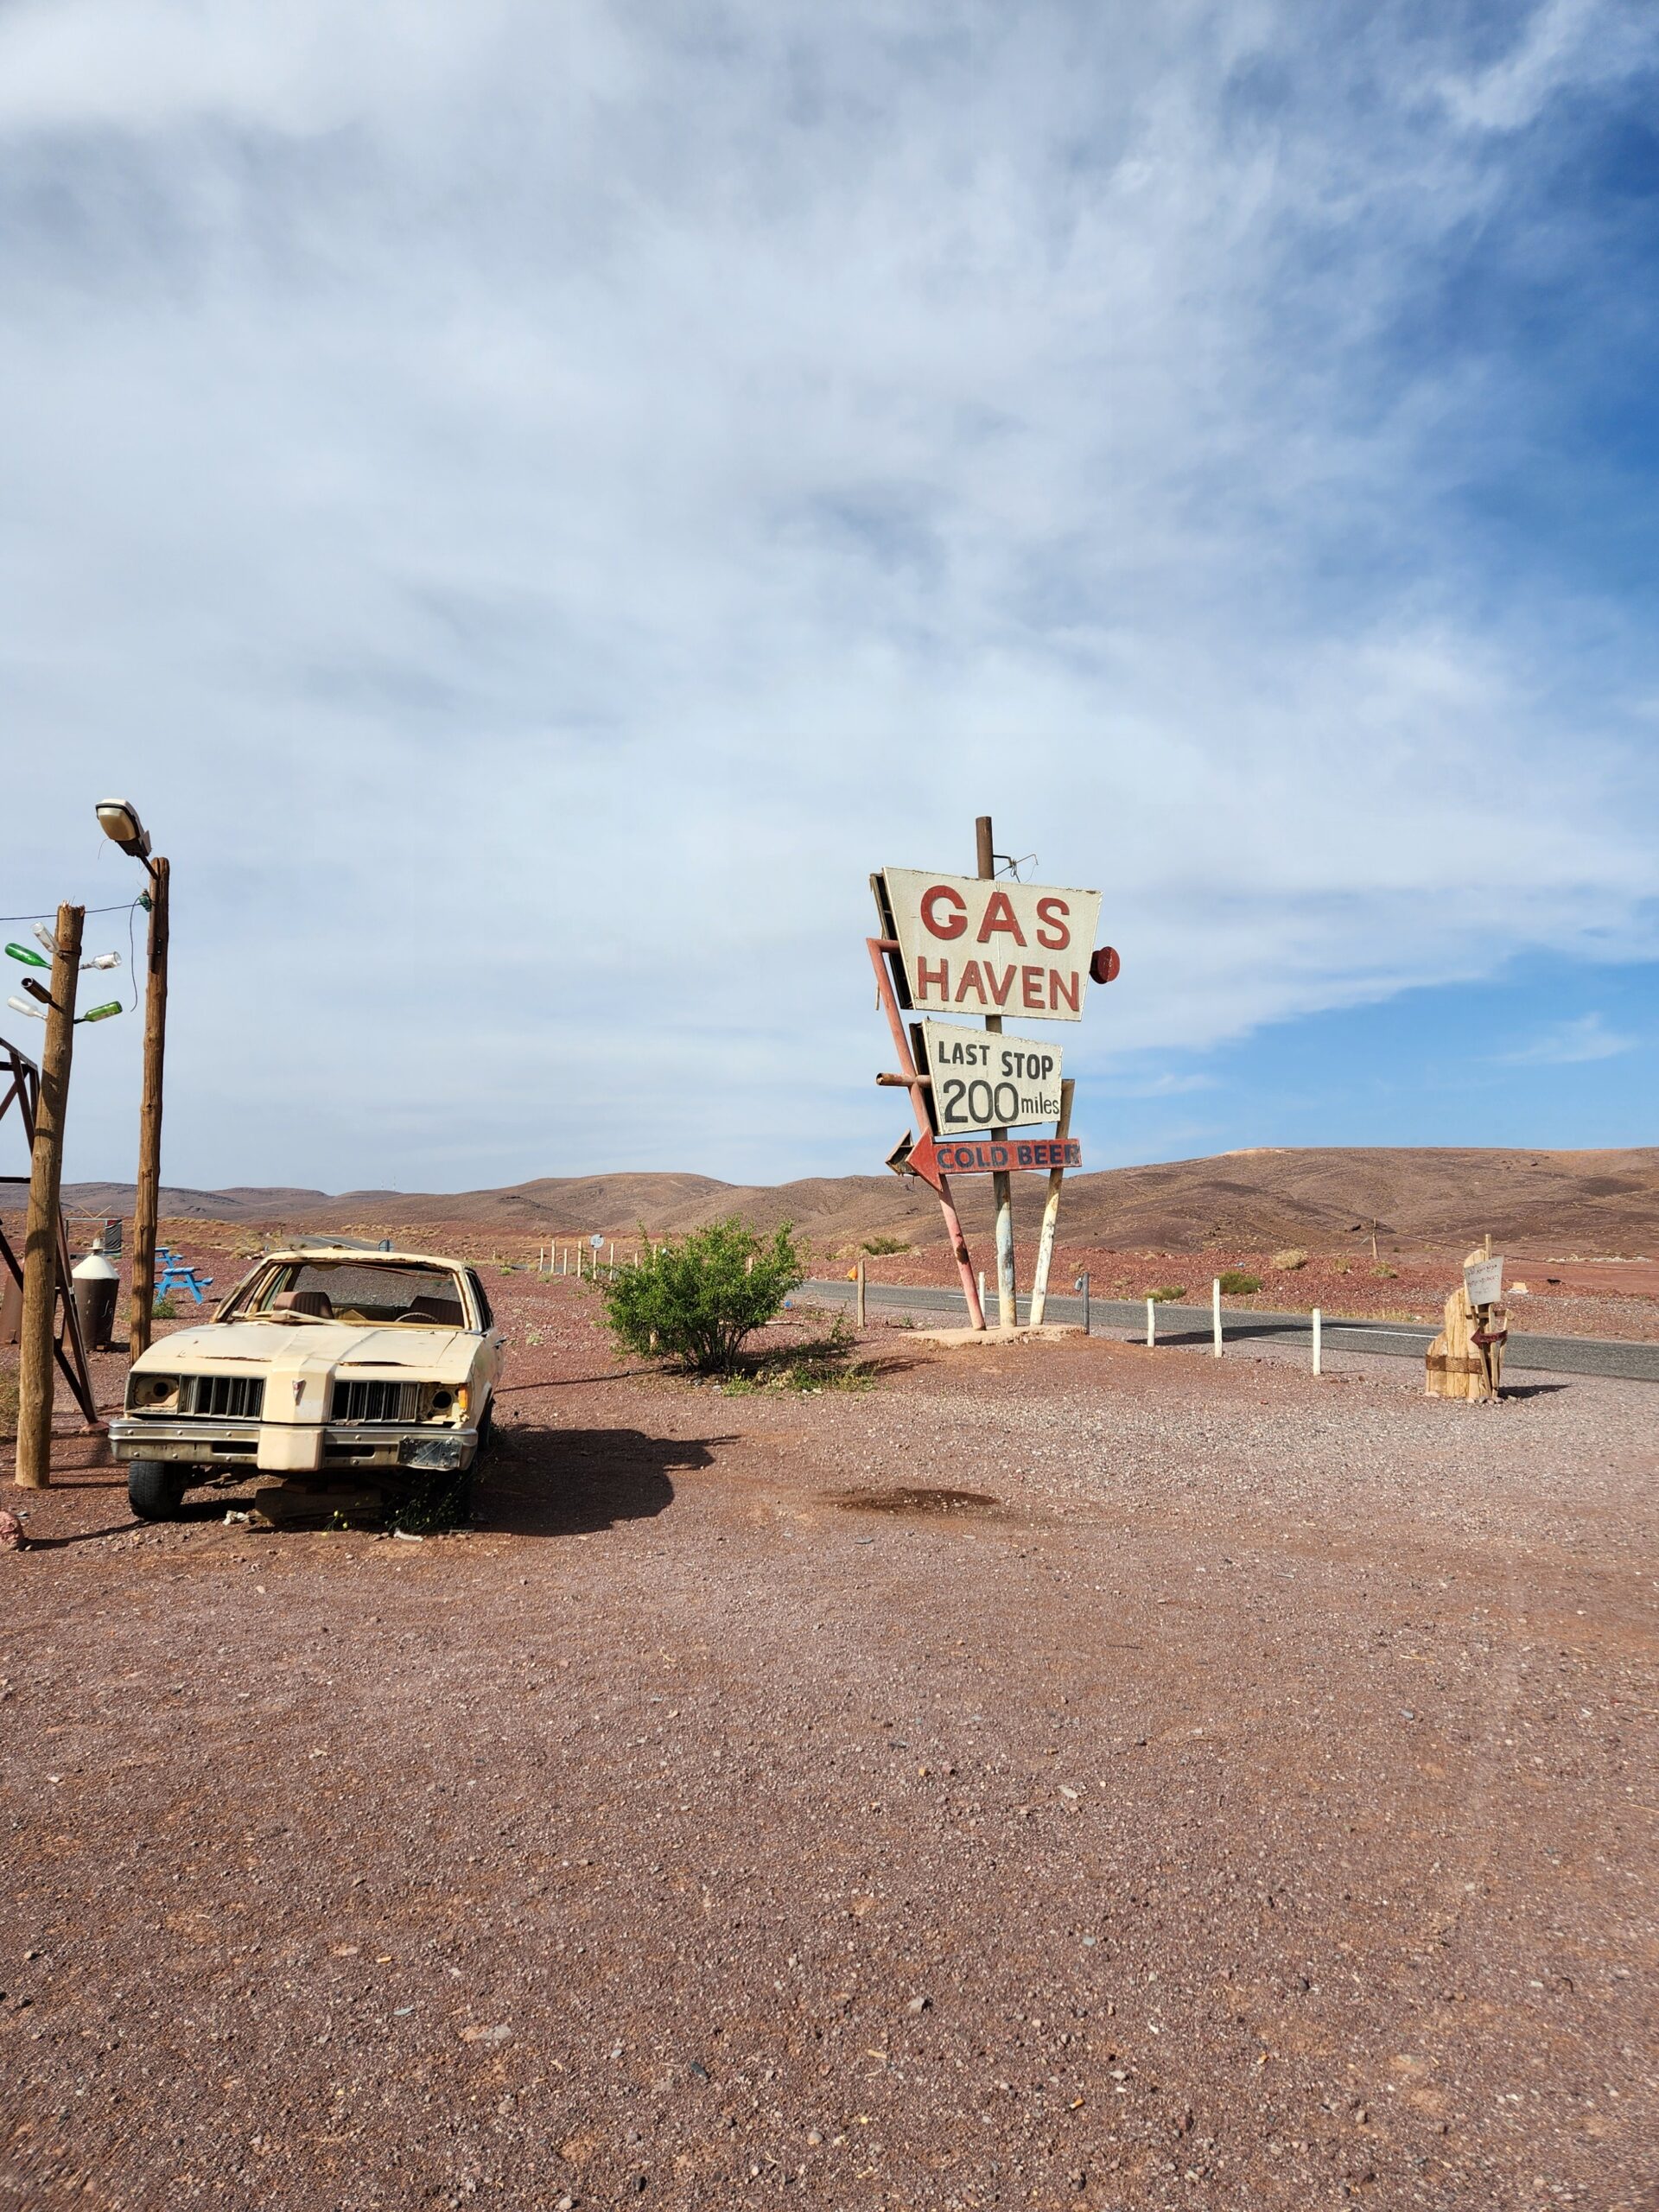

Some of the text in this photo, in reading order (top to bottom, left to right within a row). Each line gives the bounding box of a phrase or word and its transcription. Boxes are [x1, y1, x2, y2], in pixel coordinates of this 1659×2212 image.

[920, 885, 1071, 950] GAS
[918, 956, 1079, 1012] HAVEN
[938, 1040, 1053, 1080] LAST STOP
[943, 1078, 1059, 1123] 200 miles
[937, 1143, 1080, 1169] COLD BEER
